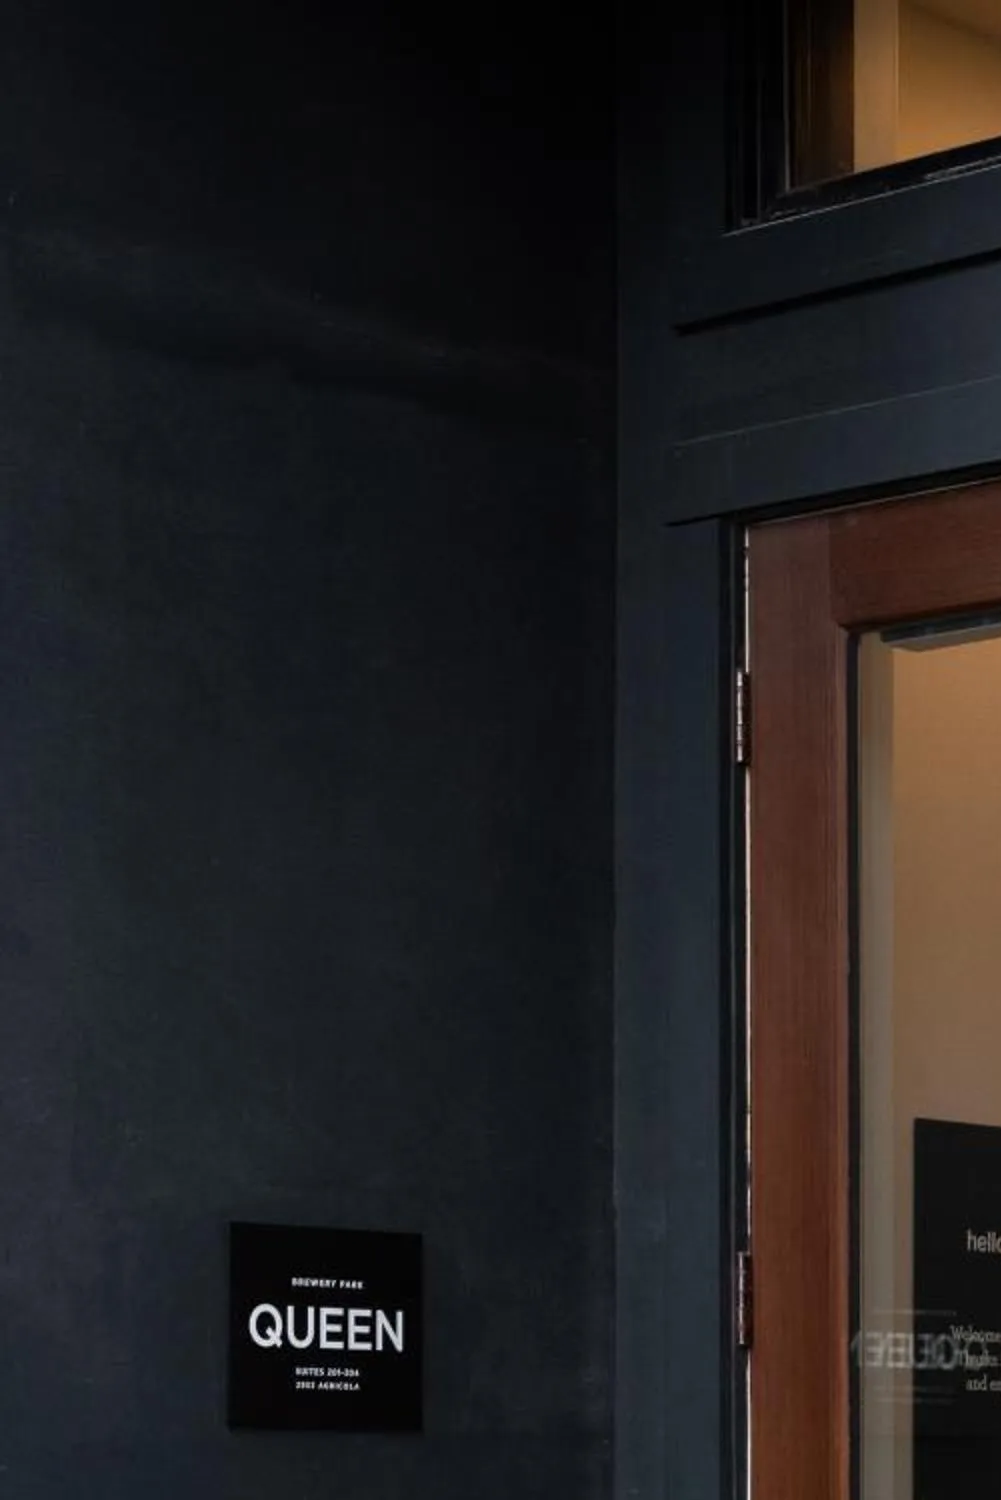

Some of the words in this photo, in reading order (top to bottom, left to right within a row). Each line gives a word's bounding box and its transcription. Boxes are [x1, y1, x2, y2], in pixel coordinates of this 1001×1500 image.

[249, 1303, 403, 1352] QUEEN
[951, 1325, 1001, 1343] Welcome
[966, 1374, 988, 1391] and
